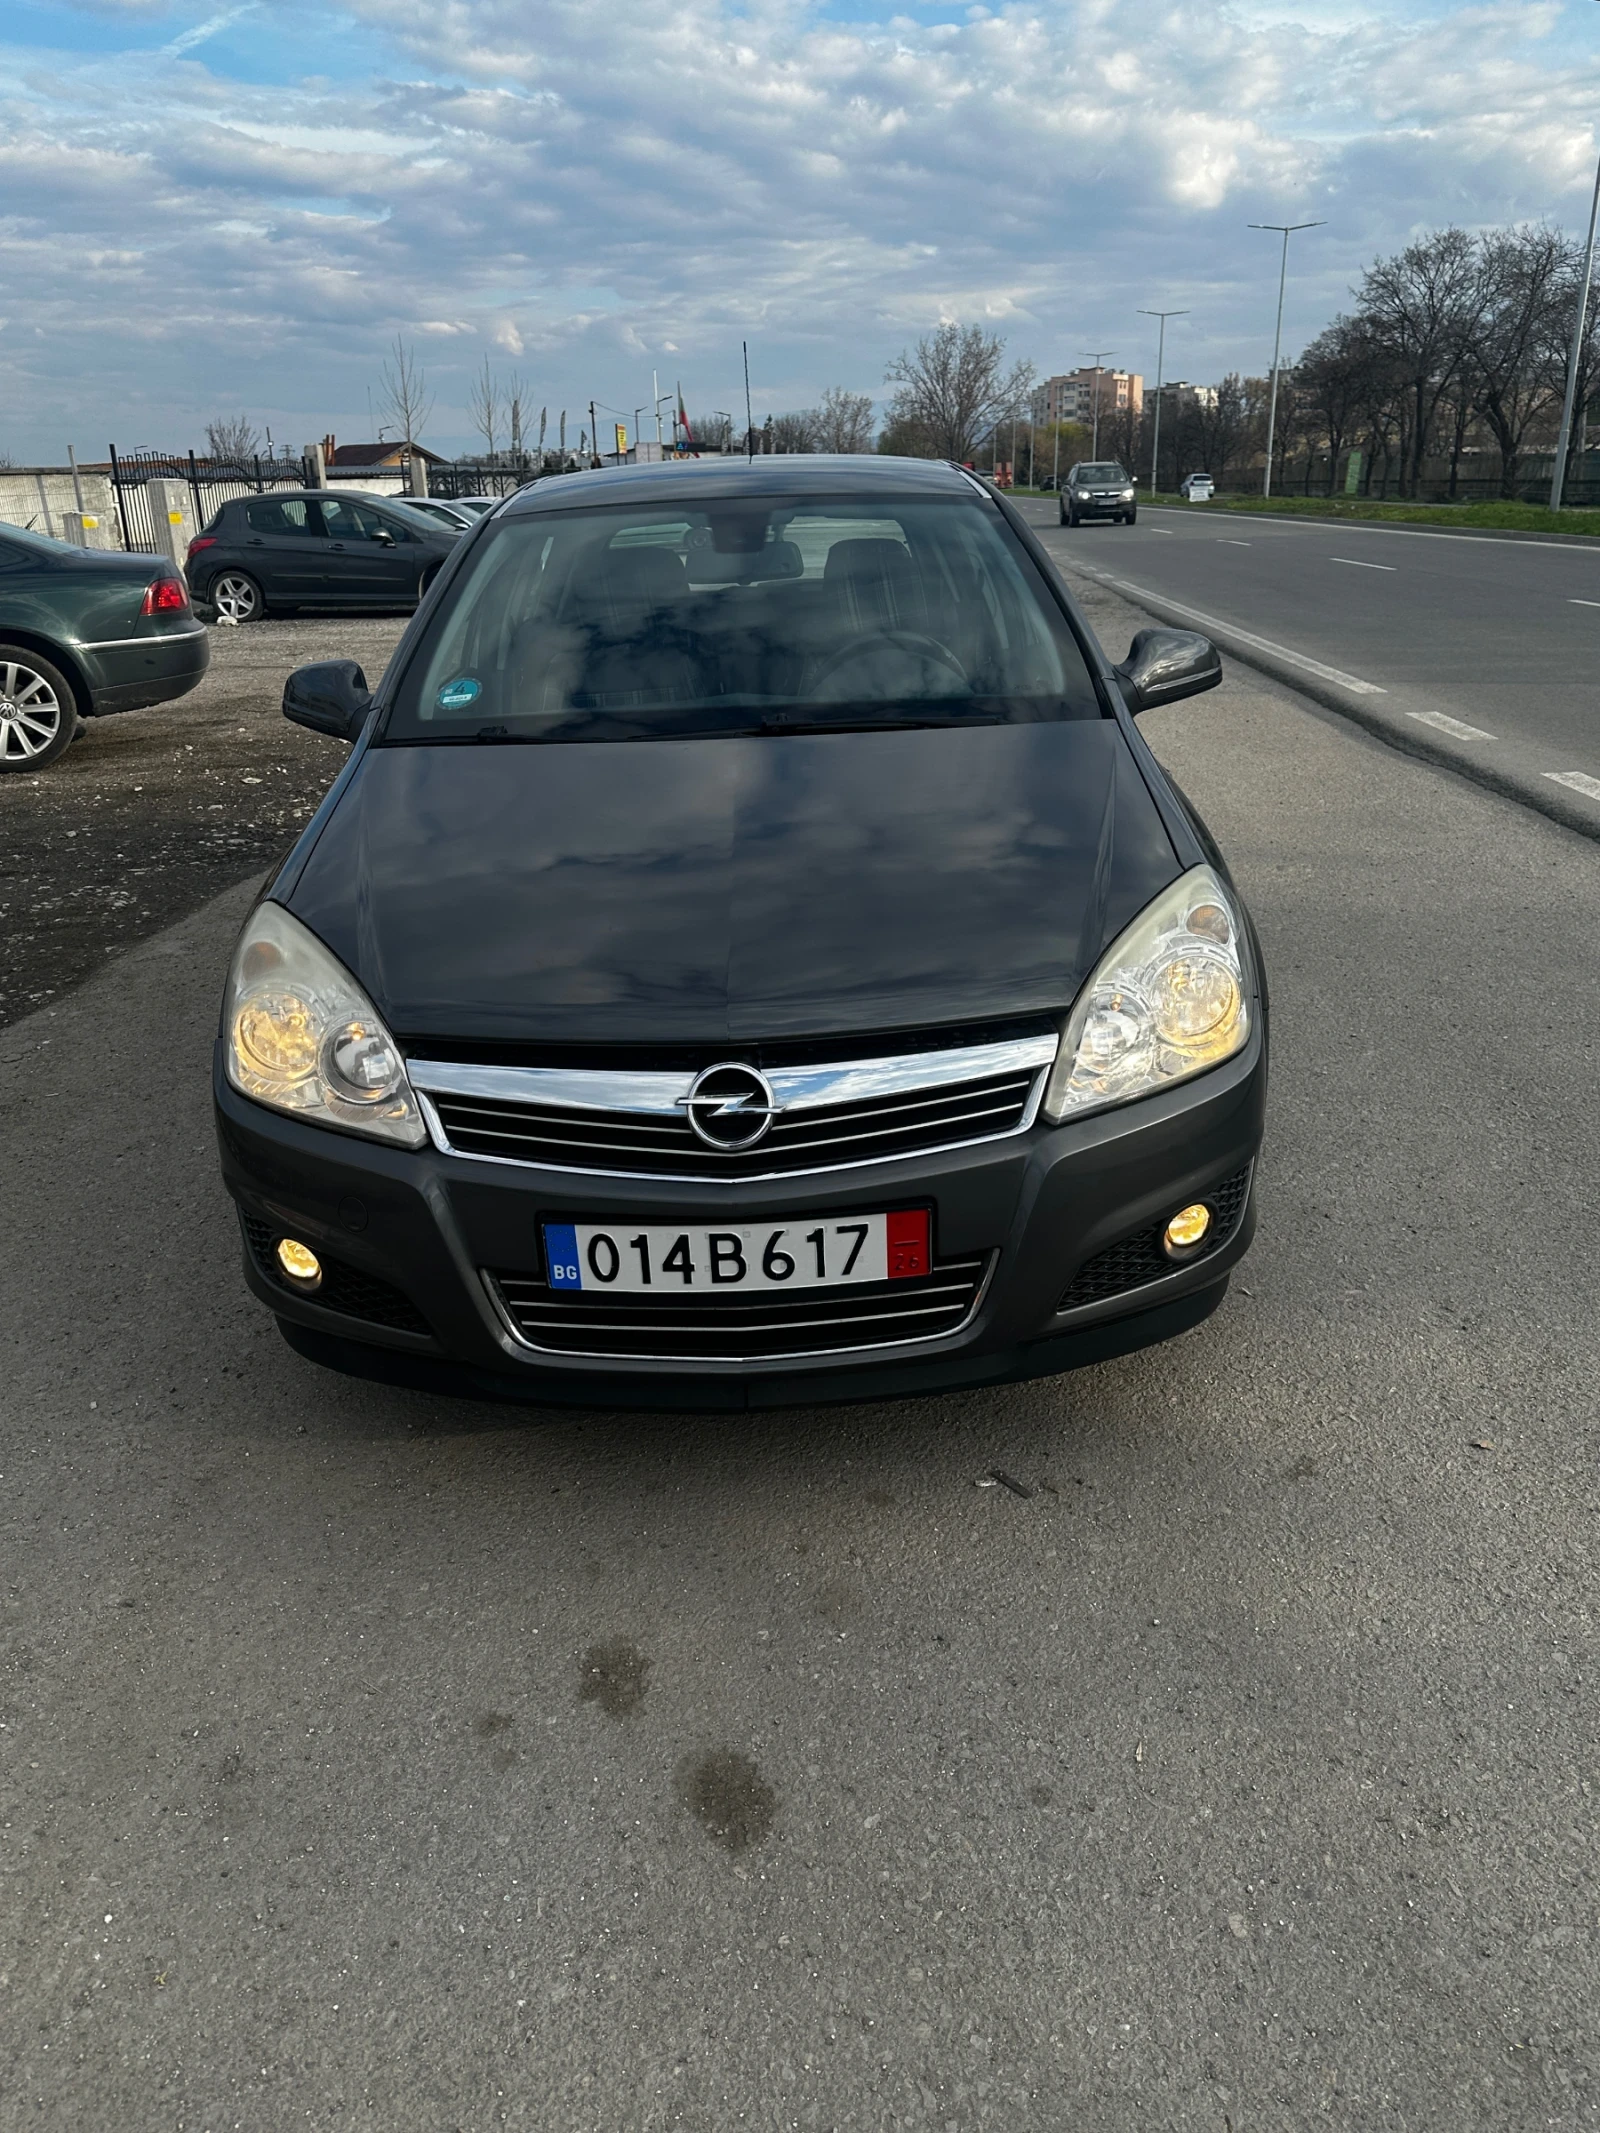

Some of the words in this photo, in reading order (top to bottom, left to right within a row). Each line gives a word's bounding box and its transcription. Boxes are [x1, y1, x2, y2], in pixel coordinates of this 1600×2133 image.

[454, 681, 466, 694] 4
[553, 1264, 577, 1280] BG
[587, 1223, 869, 1285] 014B617
